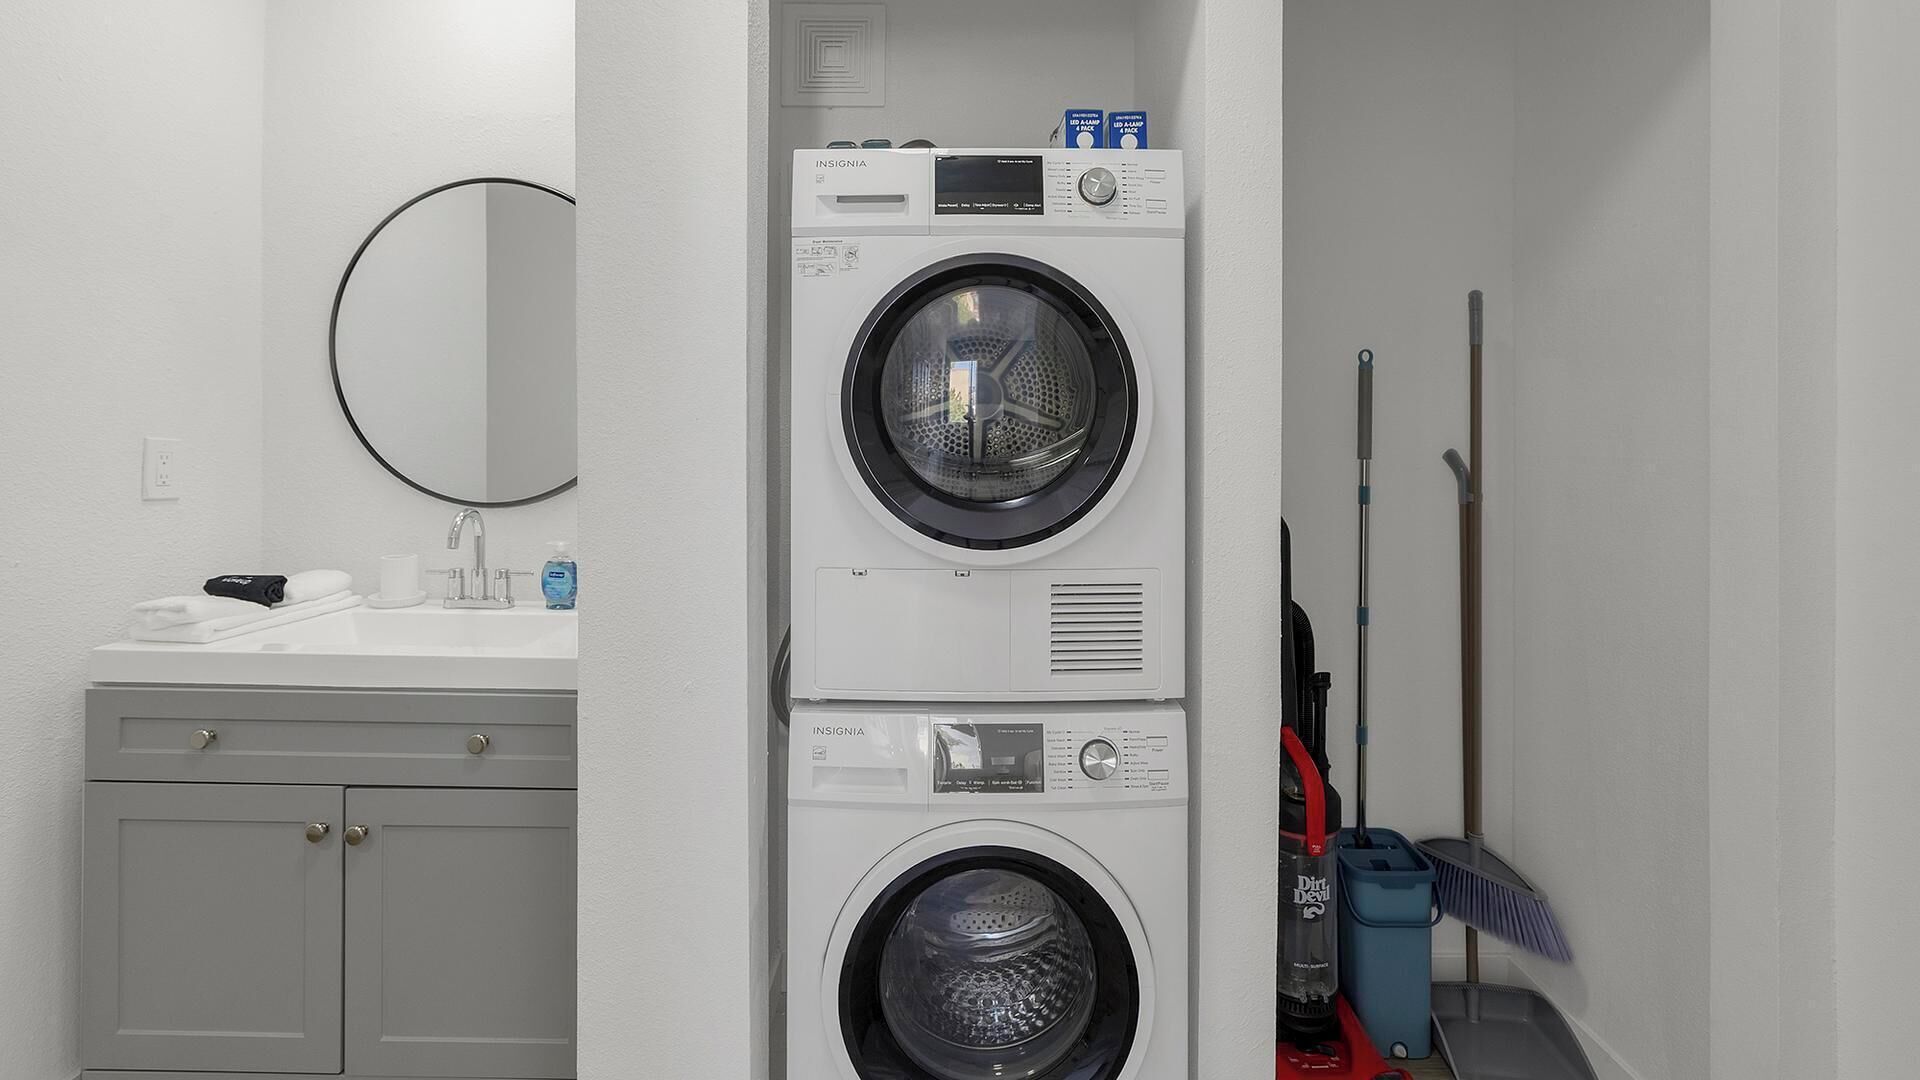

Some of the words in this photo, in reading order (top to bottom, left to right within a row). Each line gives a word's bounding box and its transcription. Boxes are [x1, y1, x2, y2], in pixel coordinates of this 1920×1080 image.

[815, 160, 868, 168] INSIGNIA
[812, 726, 865, 736] INSIGNIA
[1297, 874, 1327, 891] Dirt
[1293, 884, 1330, 904] Devil
